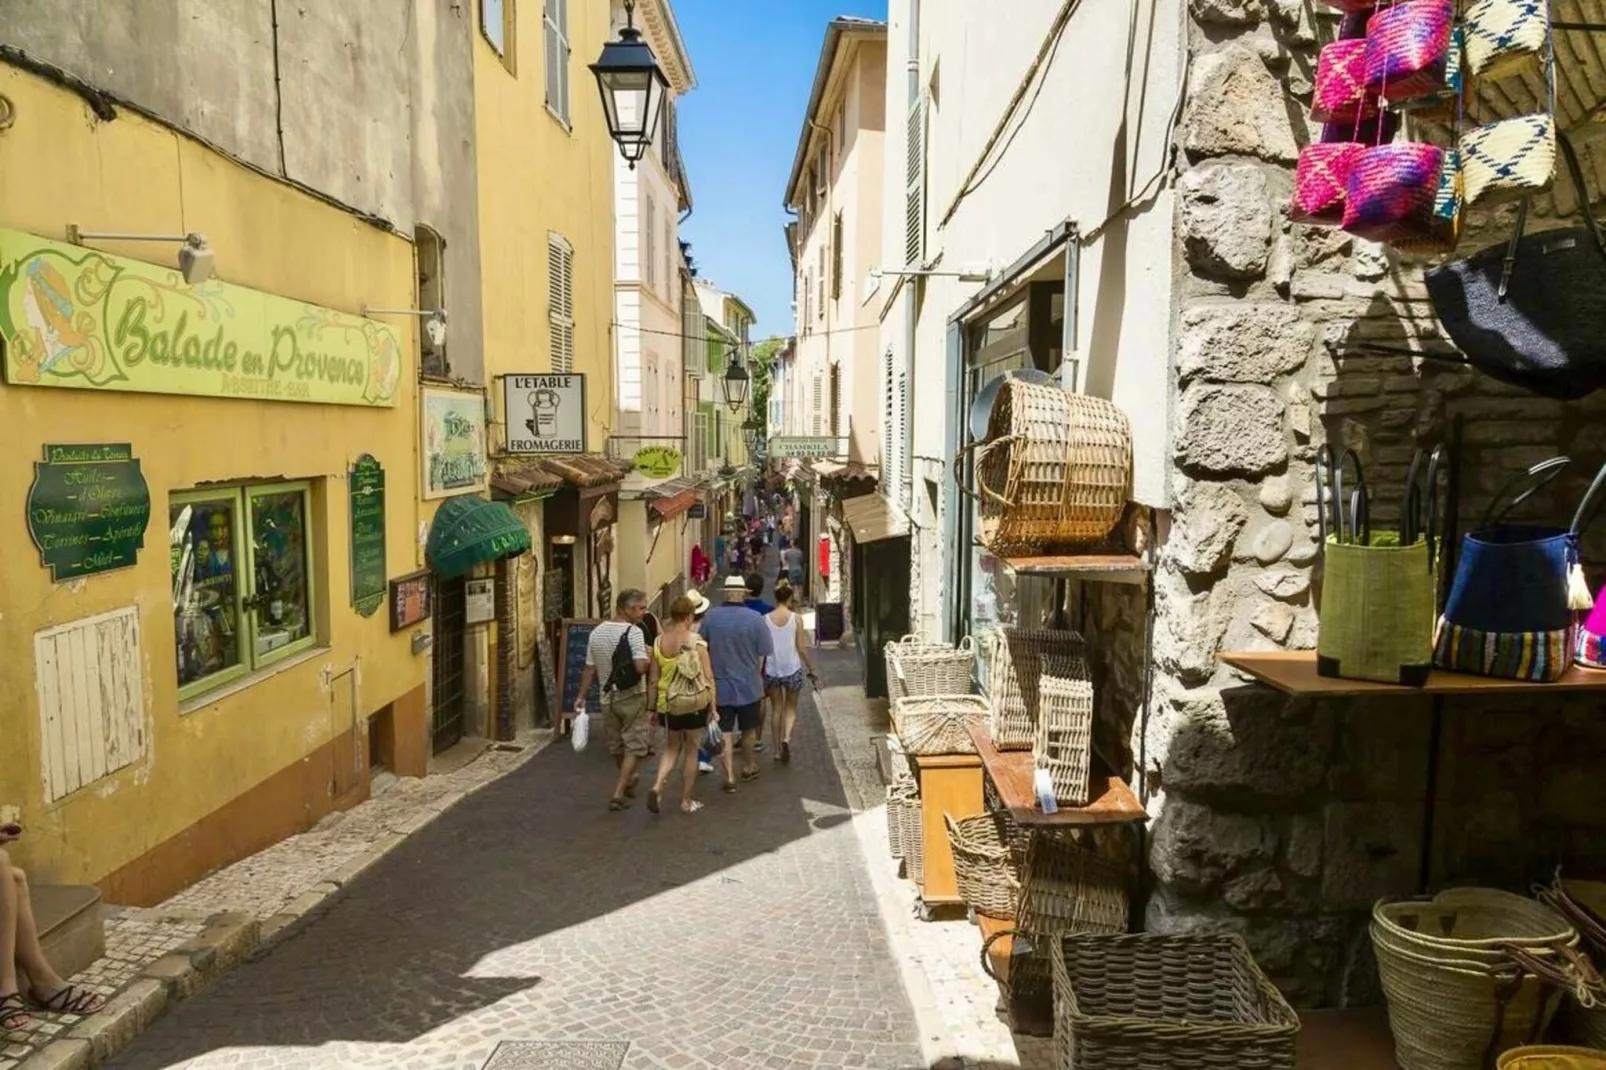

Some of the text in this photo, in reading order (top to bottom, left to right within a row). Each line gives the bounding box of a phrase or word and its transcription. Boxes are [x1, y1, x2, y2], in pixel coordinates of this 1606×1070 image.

[114, 296, 364, 386] Balade en Provence
[515, 377, 572, 388] L'ETABLE
[510, 439, 582, 450] FROMAGERIE
